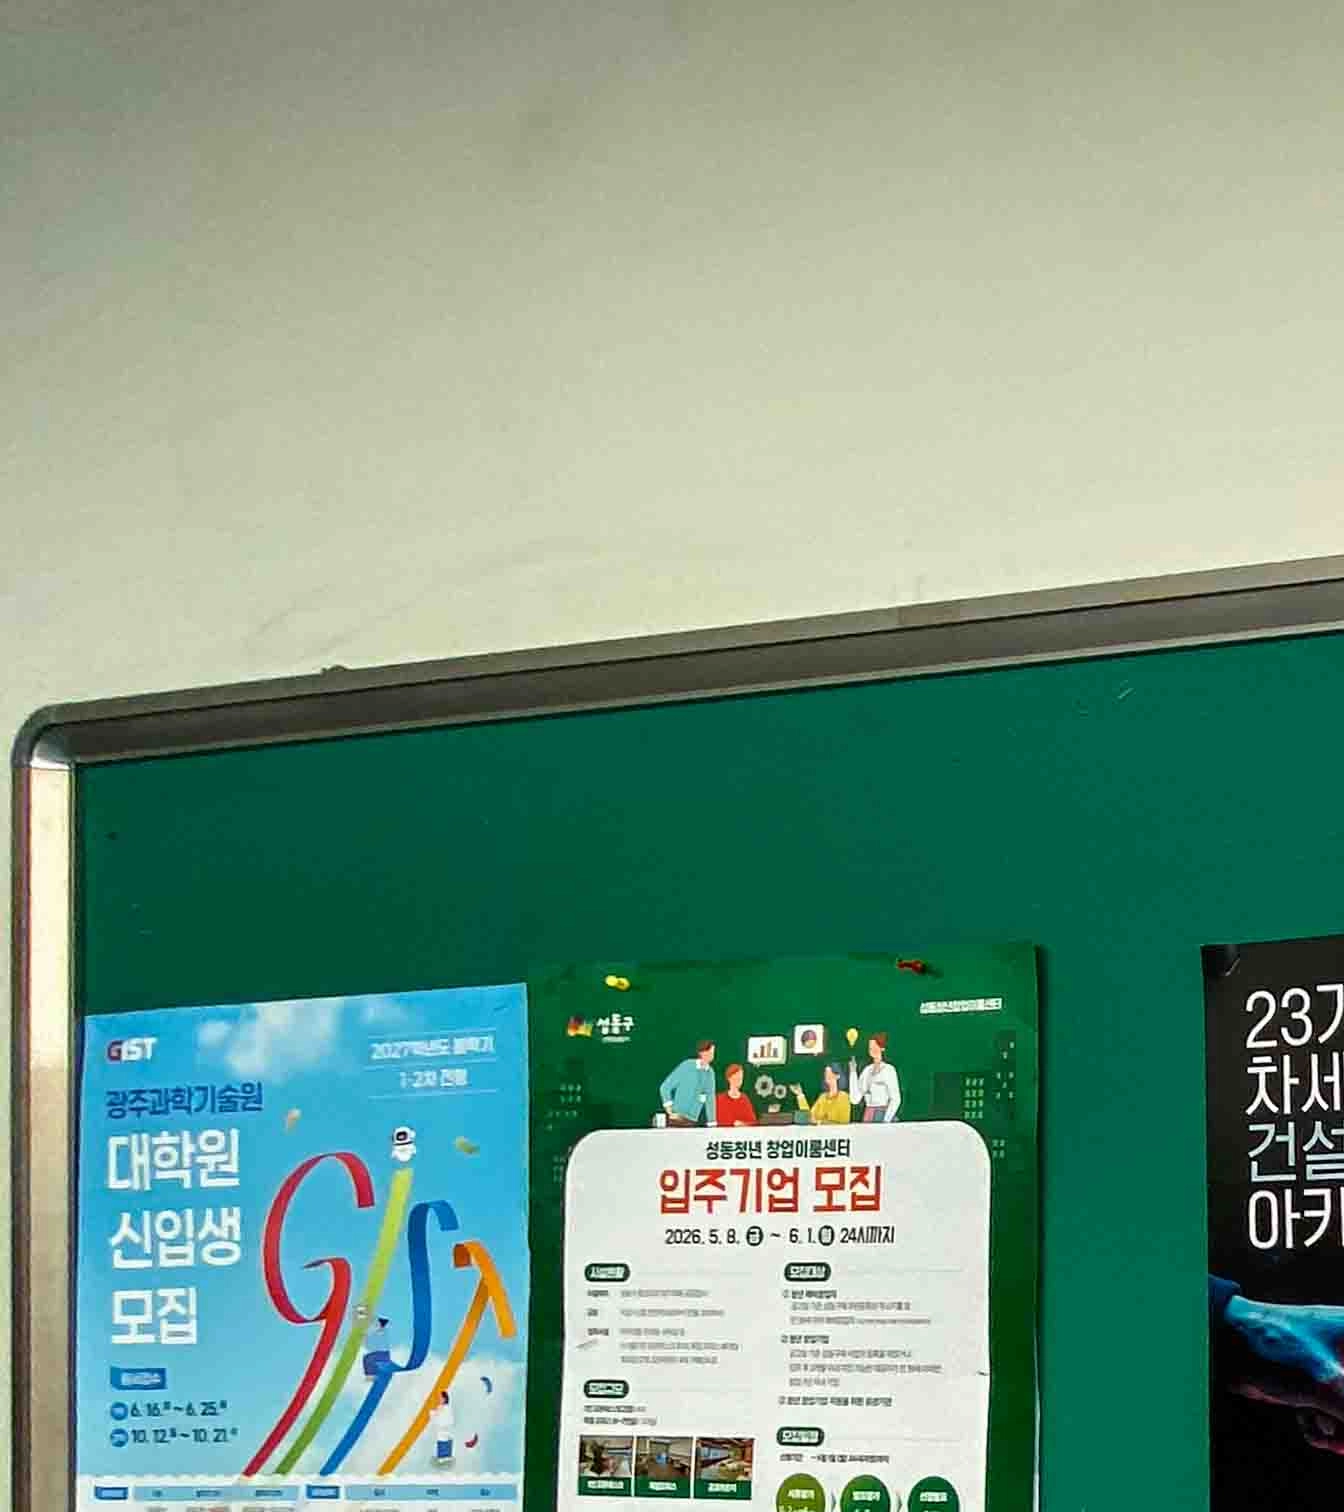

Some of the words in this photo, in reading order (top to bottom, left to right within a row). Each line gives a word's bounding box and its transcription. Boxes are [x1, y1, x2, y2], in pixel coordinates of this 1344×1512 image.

[597, 1014, 634, 1034] 성동구
[107, 1038, 156, 1062] GIST
[106, 1082, 263, 1119] 광주과학기술원
[108, 1128, 240, 1190] 대학원
[706, 1141, 762, 1160] 성동청년
[767, 1139, 850, 1159] 창업이룸센터
[660, 1168, 799, 1214] 입주기업
[813, 1166, 881, 1212] 모집
[110, 1207, 241, 1268] 신입생
[665, 1229, 705, 1244] 2026.
[709, 1229, 722, 1244] 5.
[727, 1229, 740, 1244] 8.
[840, 1226, 894, 1243] 24시까지
[112, 1287, 197, 1344] 모집
